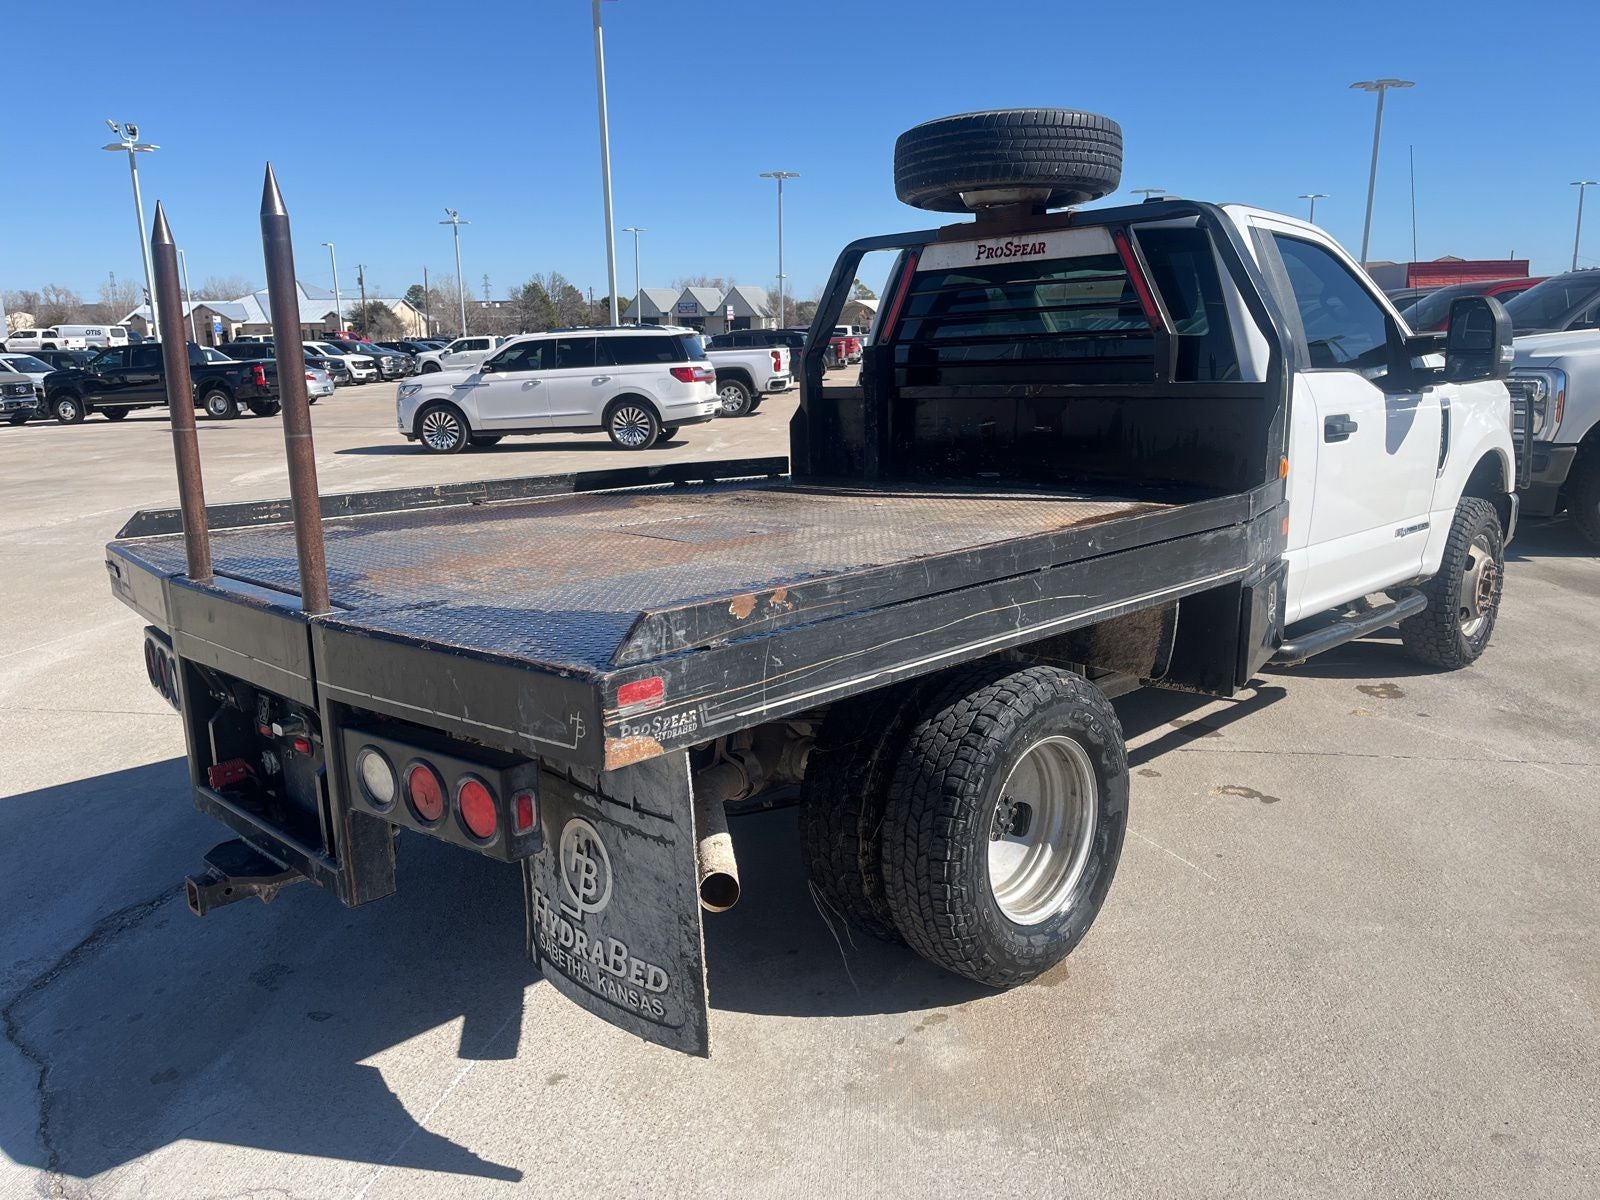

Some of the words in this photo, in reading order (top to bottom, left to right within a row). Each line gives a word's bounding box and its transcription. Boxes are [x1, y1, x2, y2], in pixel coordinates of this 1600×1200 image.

[975, 241, 1046, 260] PROSPEAR
[654, 723, 698, 742] HYDRABED
[533, 888, 669, 993] HYDRABED
[597, 975, 665, 1016] KANSAS
